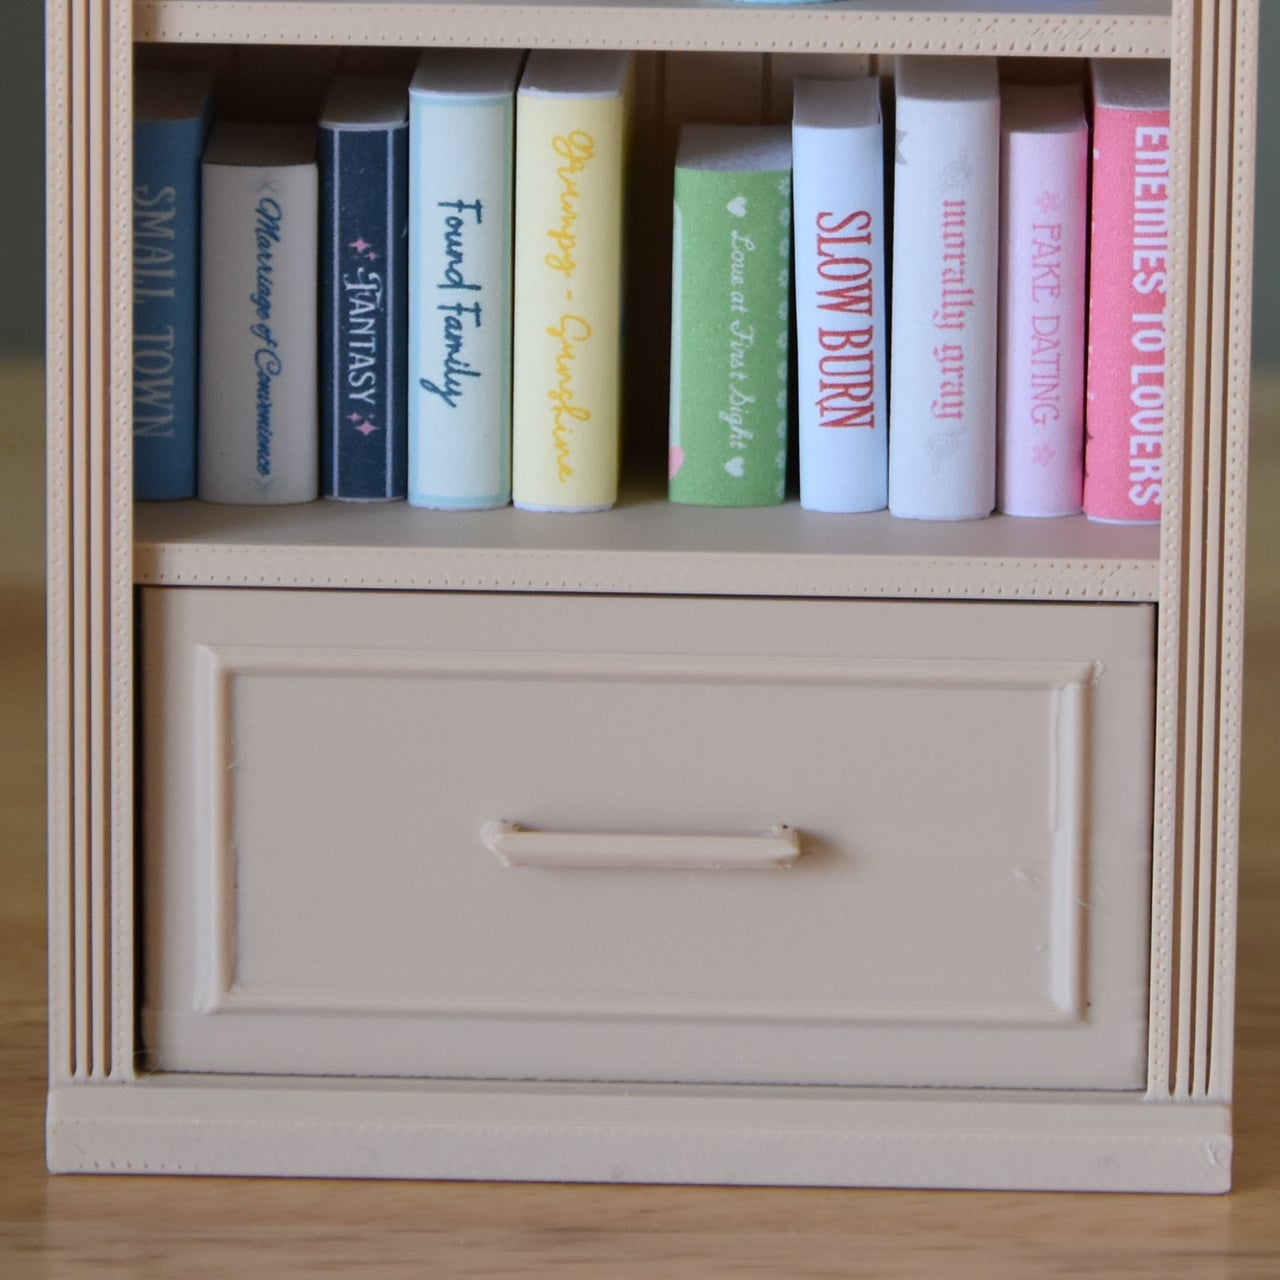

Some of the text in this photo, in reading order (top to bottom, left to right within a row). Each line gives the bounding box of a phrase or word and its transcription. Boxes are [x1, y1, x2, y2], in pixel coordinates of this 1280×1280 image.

[420, 198, 483, 409] Found Family
[544, 129, 595, 274] Grumpy
[133, 185, 176, 439] SMALL TOWN
[250, 197, 283, 477] Marriage of Convenience
[343, 267, 382, 407] FANTASY
[546, 314, 593, 484] Sunshine
[719, 229, 756, 450] Love at First Sight
[815, 209, 876, 430] SLOW BURN
[930, 198, 975, 422] morally gray
[1030, 222, 1063, 428] FAKE DATING
[1128, 364, 1167, 507] LOVERS
